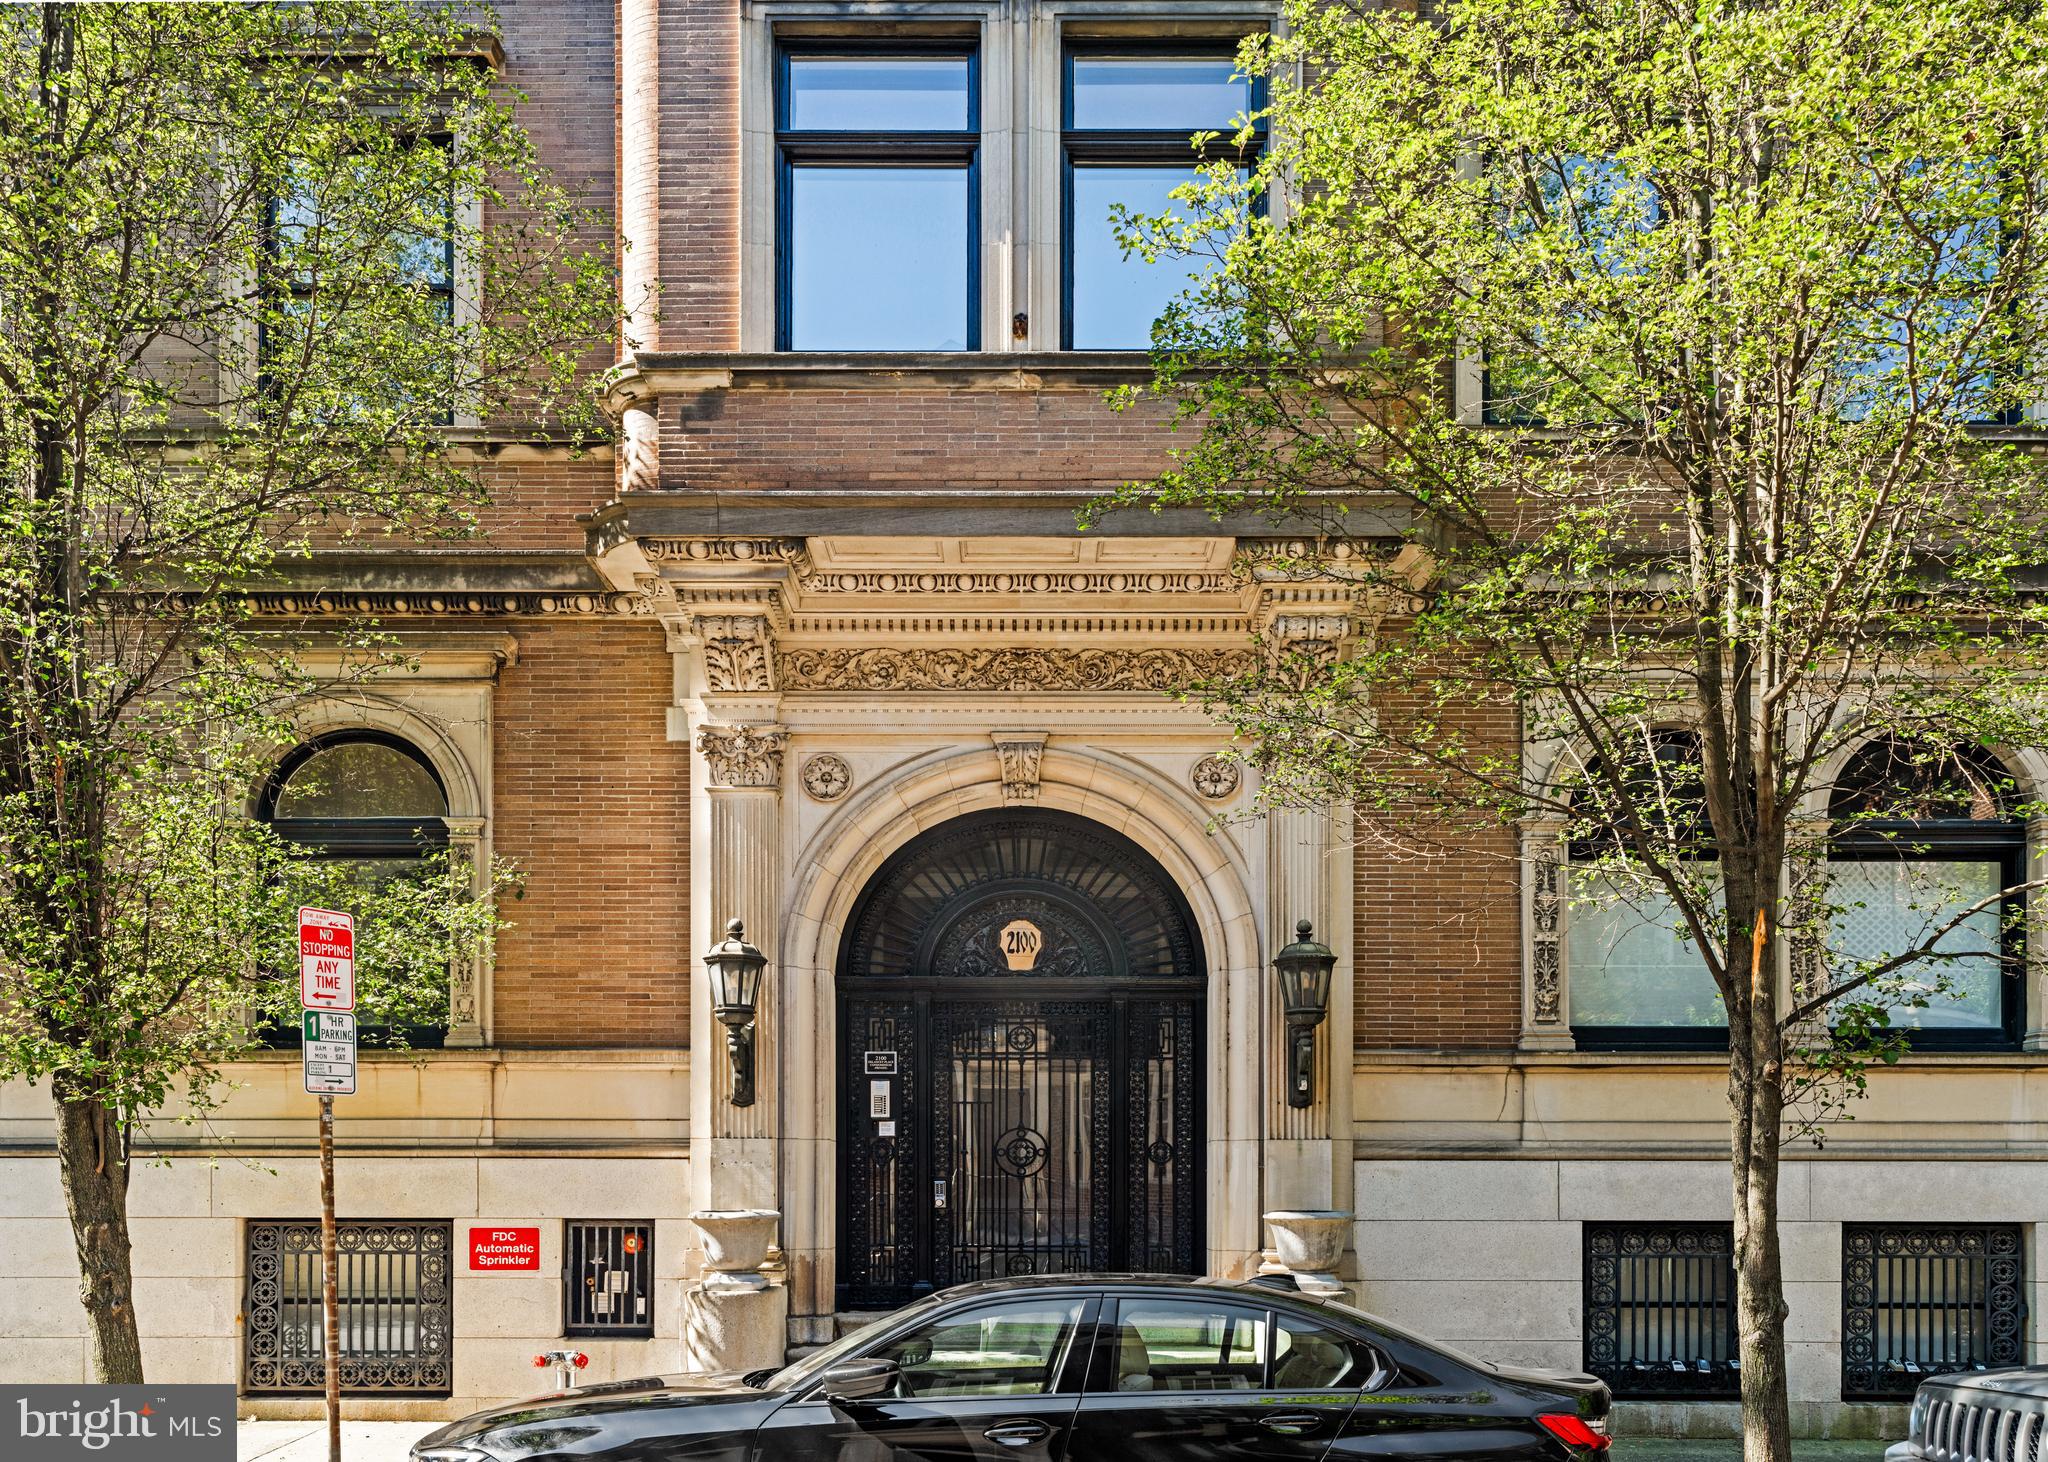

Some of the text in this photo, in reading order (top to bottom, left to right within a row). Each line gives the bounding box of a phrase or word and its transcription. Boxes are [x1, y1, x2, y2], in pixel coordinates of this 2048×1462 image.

[319, 928, 334, 942] NO
[1006, 930, 1037, 954] 2100
[303, 941, 350, 957] STOPPING
[316, 960, 339, 974] ANY
[315, 975, 341, 989] TIME
[309, 1015, 344, 1037] 1 HR
[321, 1028, 352, 1041] PARKING
[334, 1045, 346, 1053] 6PM
[492, 1231, 517, 1242] FDC
[475, 1243, 534, 1253] Automatic
[479, 1255, 531, 1266] Sprinkler
